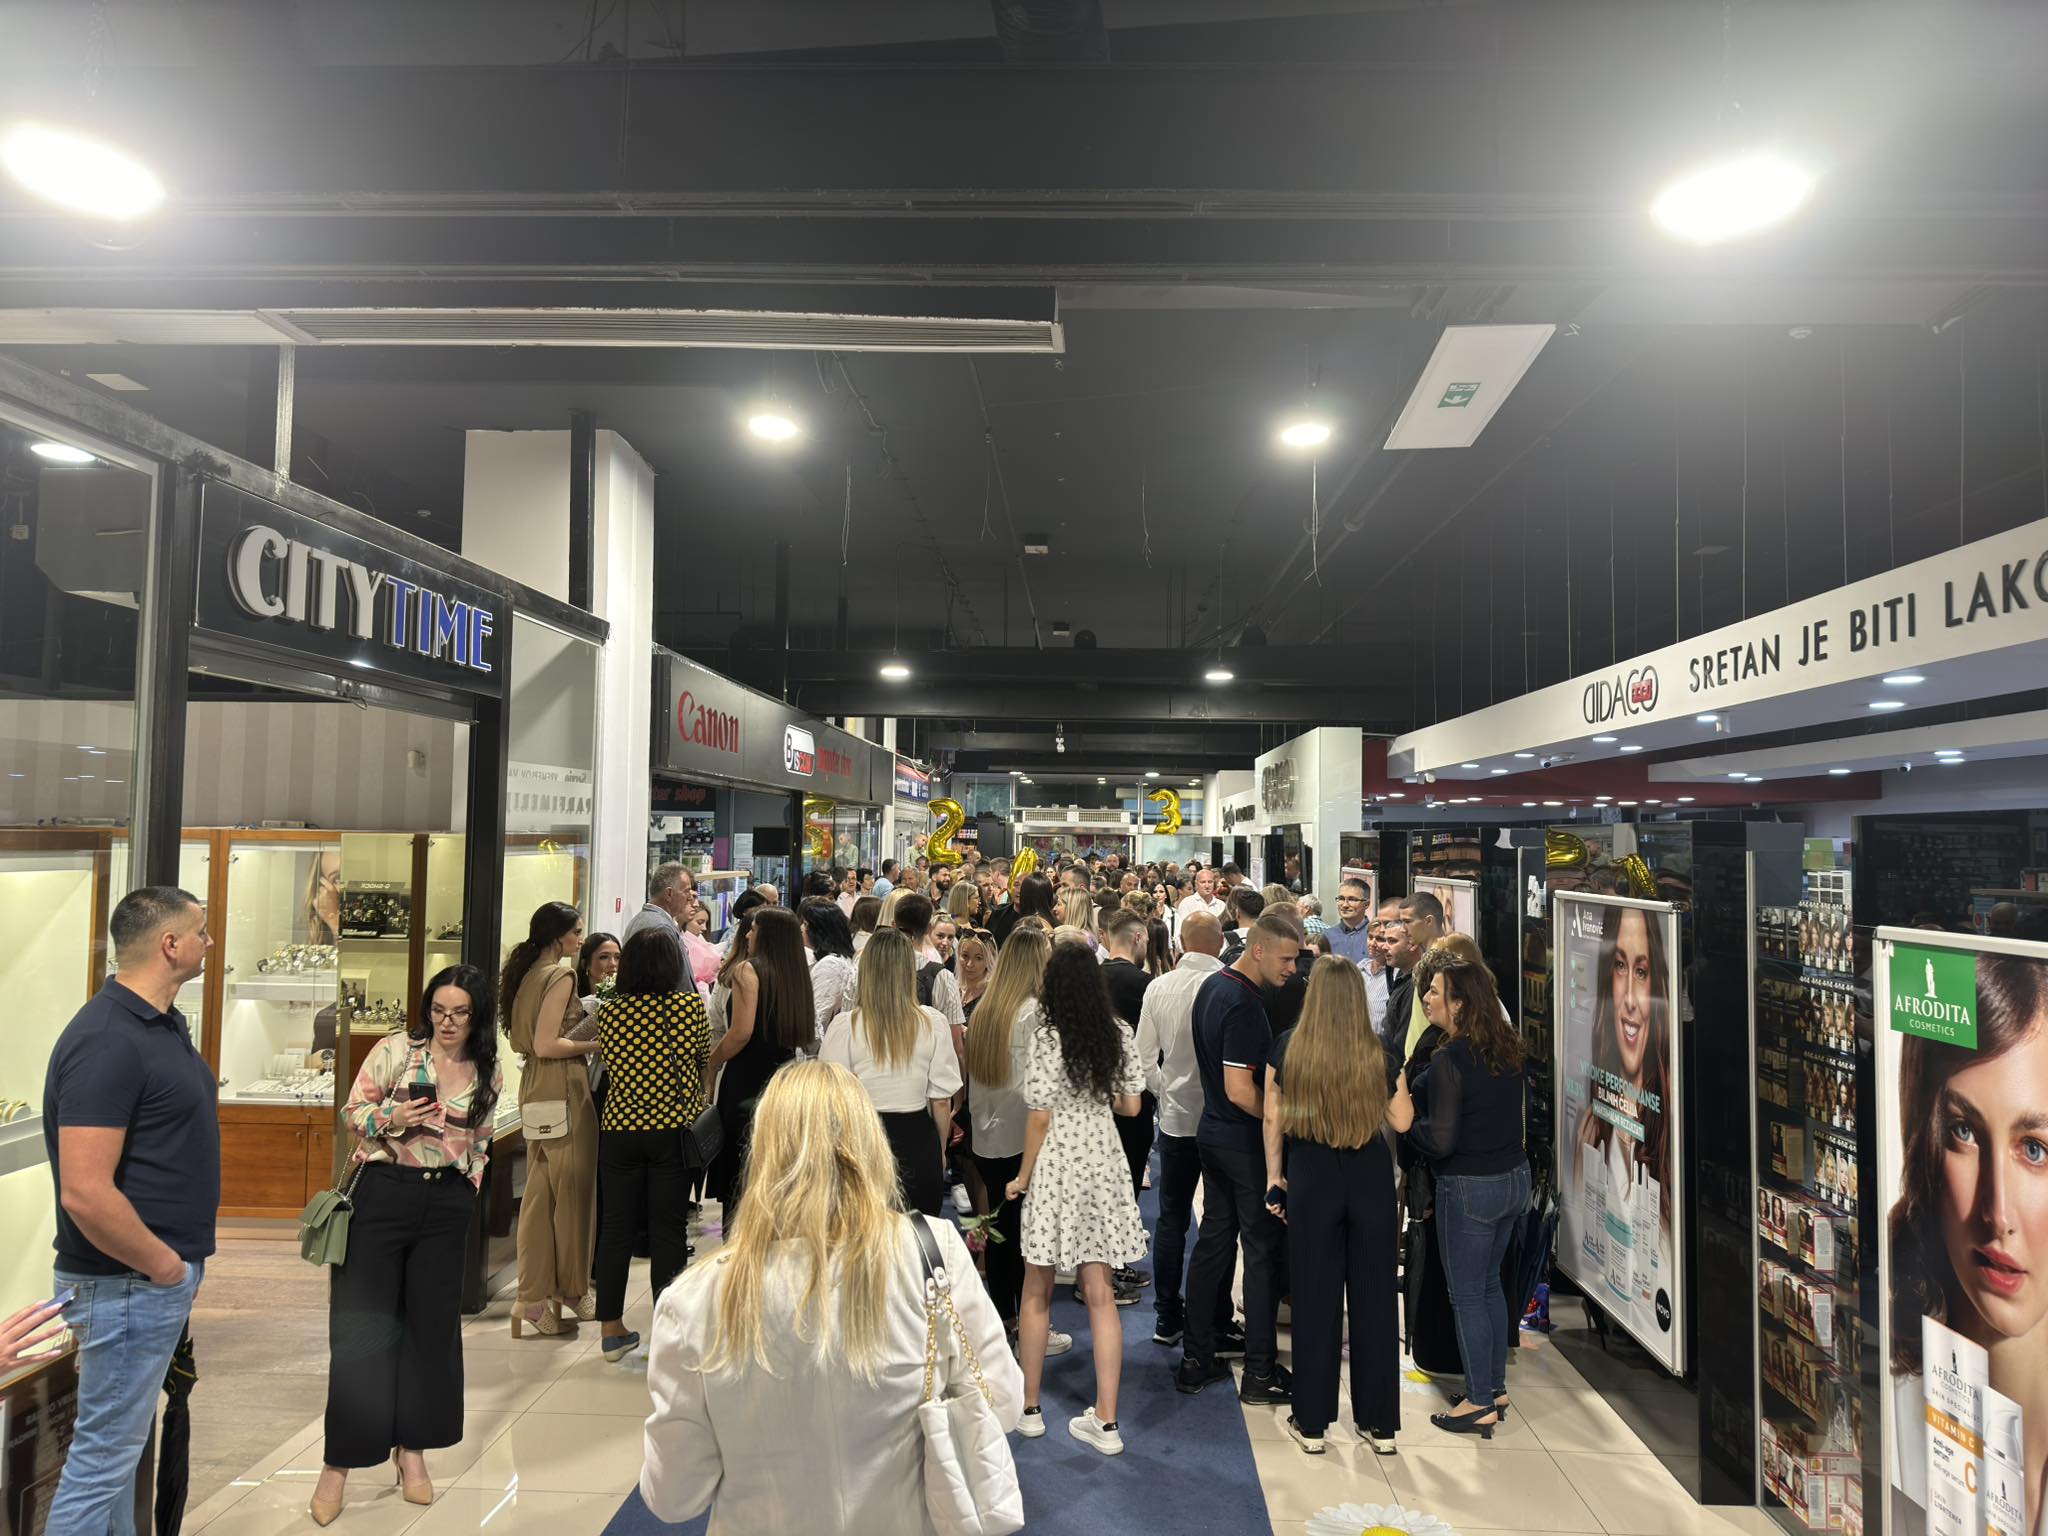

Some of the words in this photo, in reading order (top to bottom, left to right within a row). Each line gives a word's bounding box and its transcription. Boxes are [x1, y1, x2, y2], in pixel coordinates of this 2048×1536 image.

[1689, 634, 1781, 693] SRETAN
[1798, 620, 1829, 666] JE
[1850, 593, 1916, 652] BITI
[677, 690, 740, 754] Canon
[1582, 909, 1593, 921] Ana
[1895, 994, 1971, 1026] AFRODITA
[1909, 1018, 1955, 1037] COSMETICS
[1605, 1069, 1661, 1114] PERFORMANSE
[1656, 1304, 1670, 1320] NOVO
[1932, 1363, 1979, 1401] AFRODITA
[1931, 1406, 1966, 1443] VITAMIN
[1968, 1437, 1975, 1449] C
[1964, 1461, 1978, 1494] C
[1985, 1488, 2023, 1522] AFRODITA
